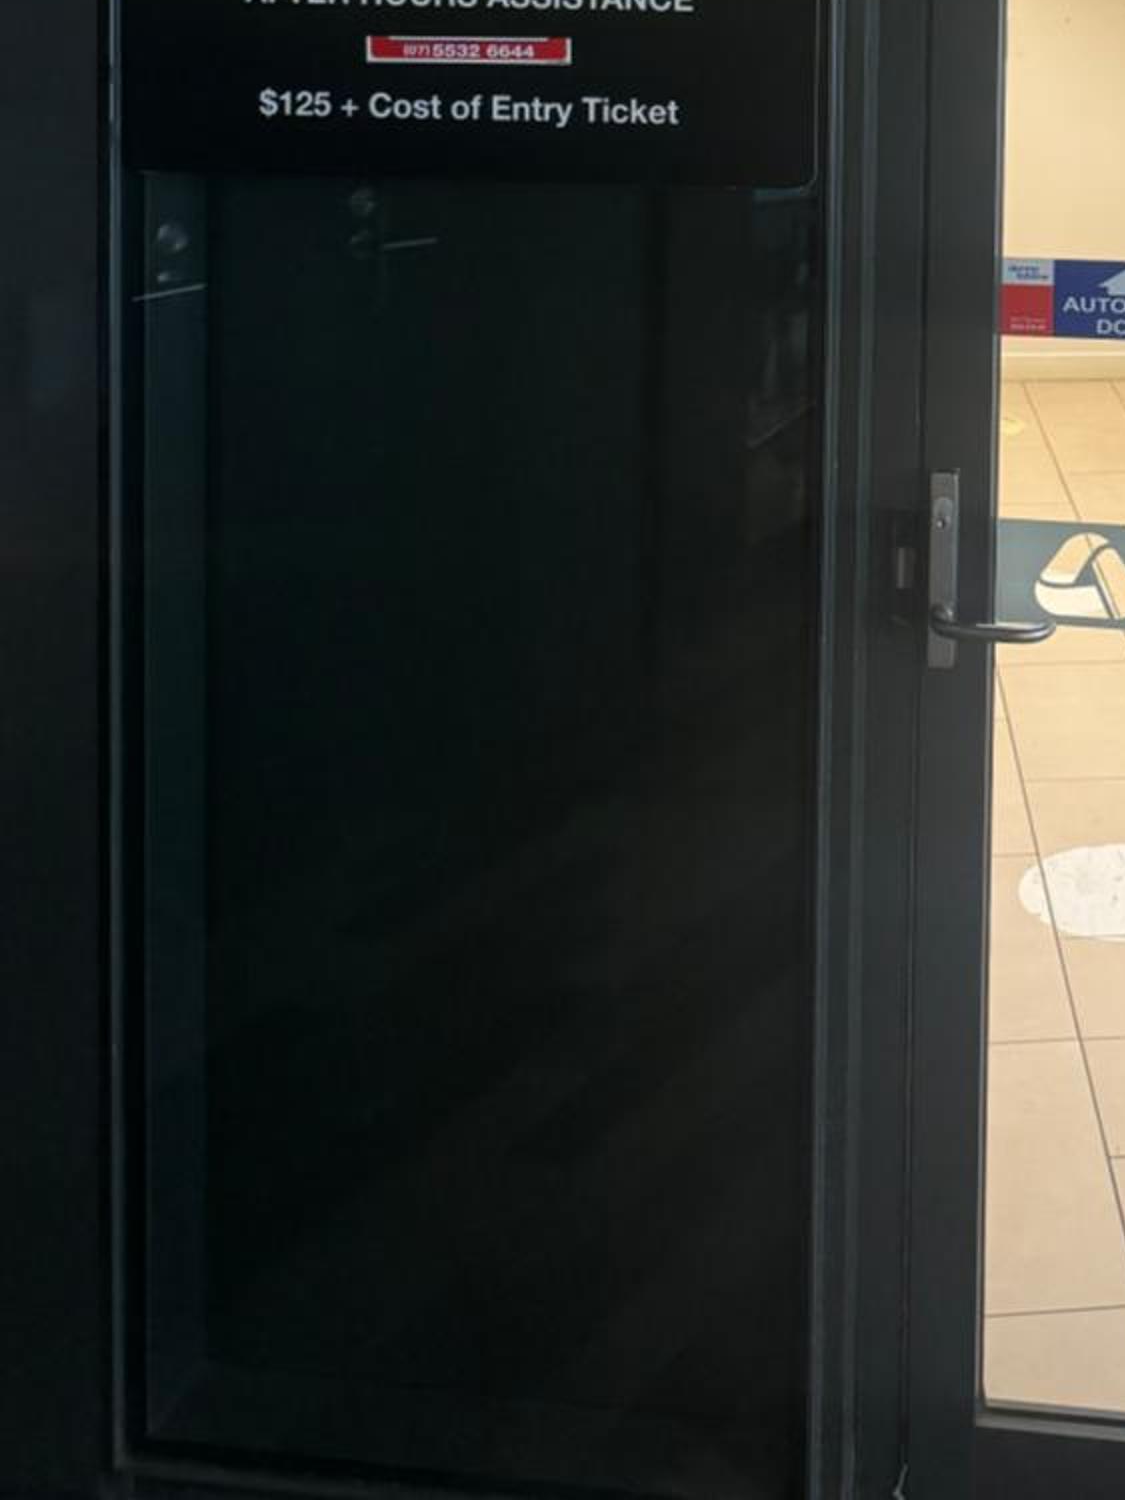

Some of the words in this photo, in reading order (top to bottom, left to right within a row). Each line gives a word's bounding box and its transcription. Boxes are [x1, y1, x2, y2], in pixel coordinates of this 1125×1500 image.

[486, 44, 535, 60] 6644
[258, 88, 331, 119] $125
[342, 100, 357, 115] +
[369, 94, 441, 120] Cost
[450, 95, 482, 121] of
[491, 96, 573, 128] Entry
[582, 97, 679, 126] Ticket
